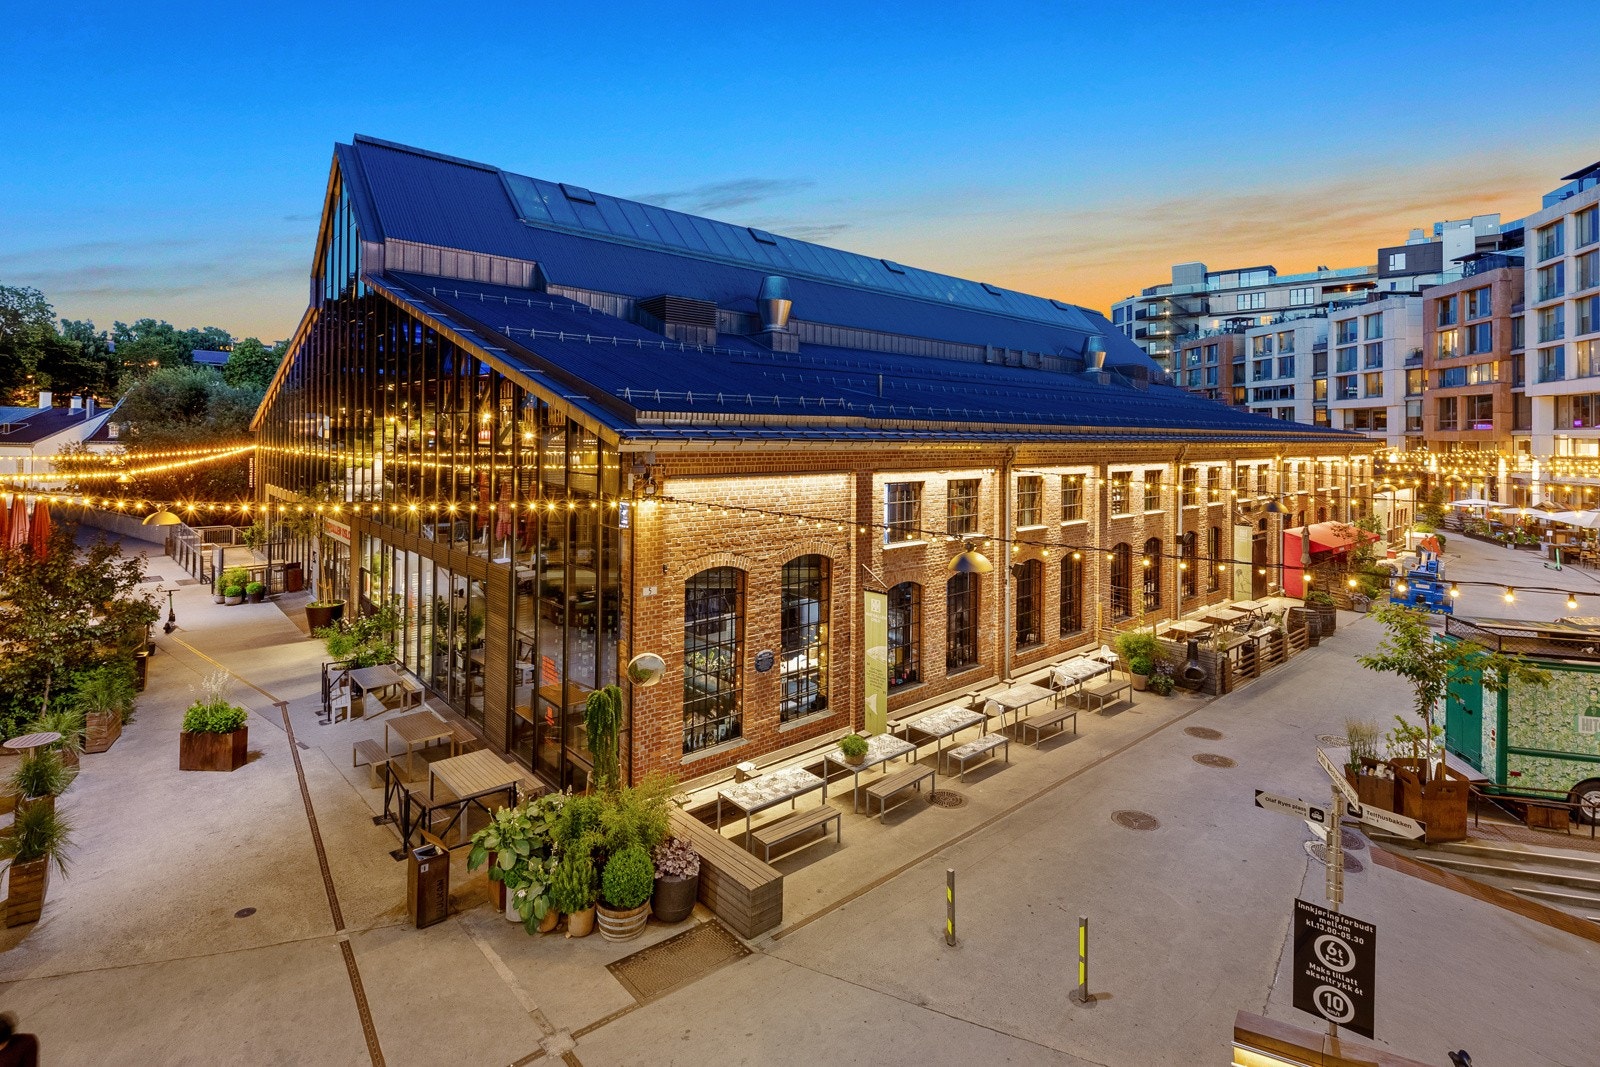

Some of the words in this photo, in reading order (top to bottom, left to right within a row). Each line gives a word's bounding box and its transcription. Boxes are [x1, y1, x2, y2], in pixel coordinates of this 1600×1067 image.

[1581, 717, 1600, 732] HIT
[1277, 800, 1291, 808] Ryes
[1292, 804, 1306, 812] plass
[1319, 917, 1351, 932] mellom
[1341, 916, 1374, 933] forbudt
[1326, 941, 1344, 959] 6t
[1305, 969, 1353, 993] akseltrykk
[1354, 987, 1363, 996] 6t
[1309, 962, 1331, 976] Maks
[1332, 971, 1358, 986] tillatt
[1324, 992, 1344, 1012] 10
